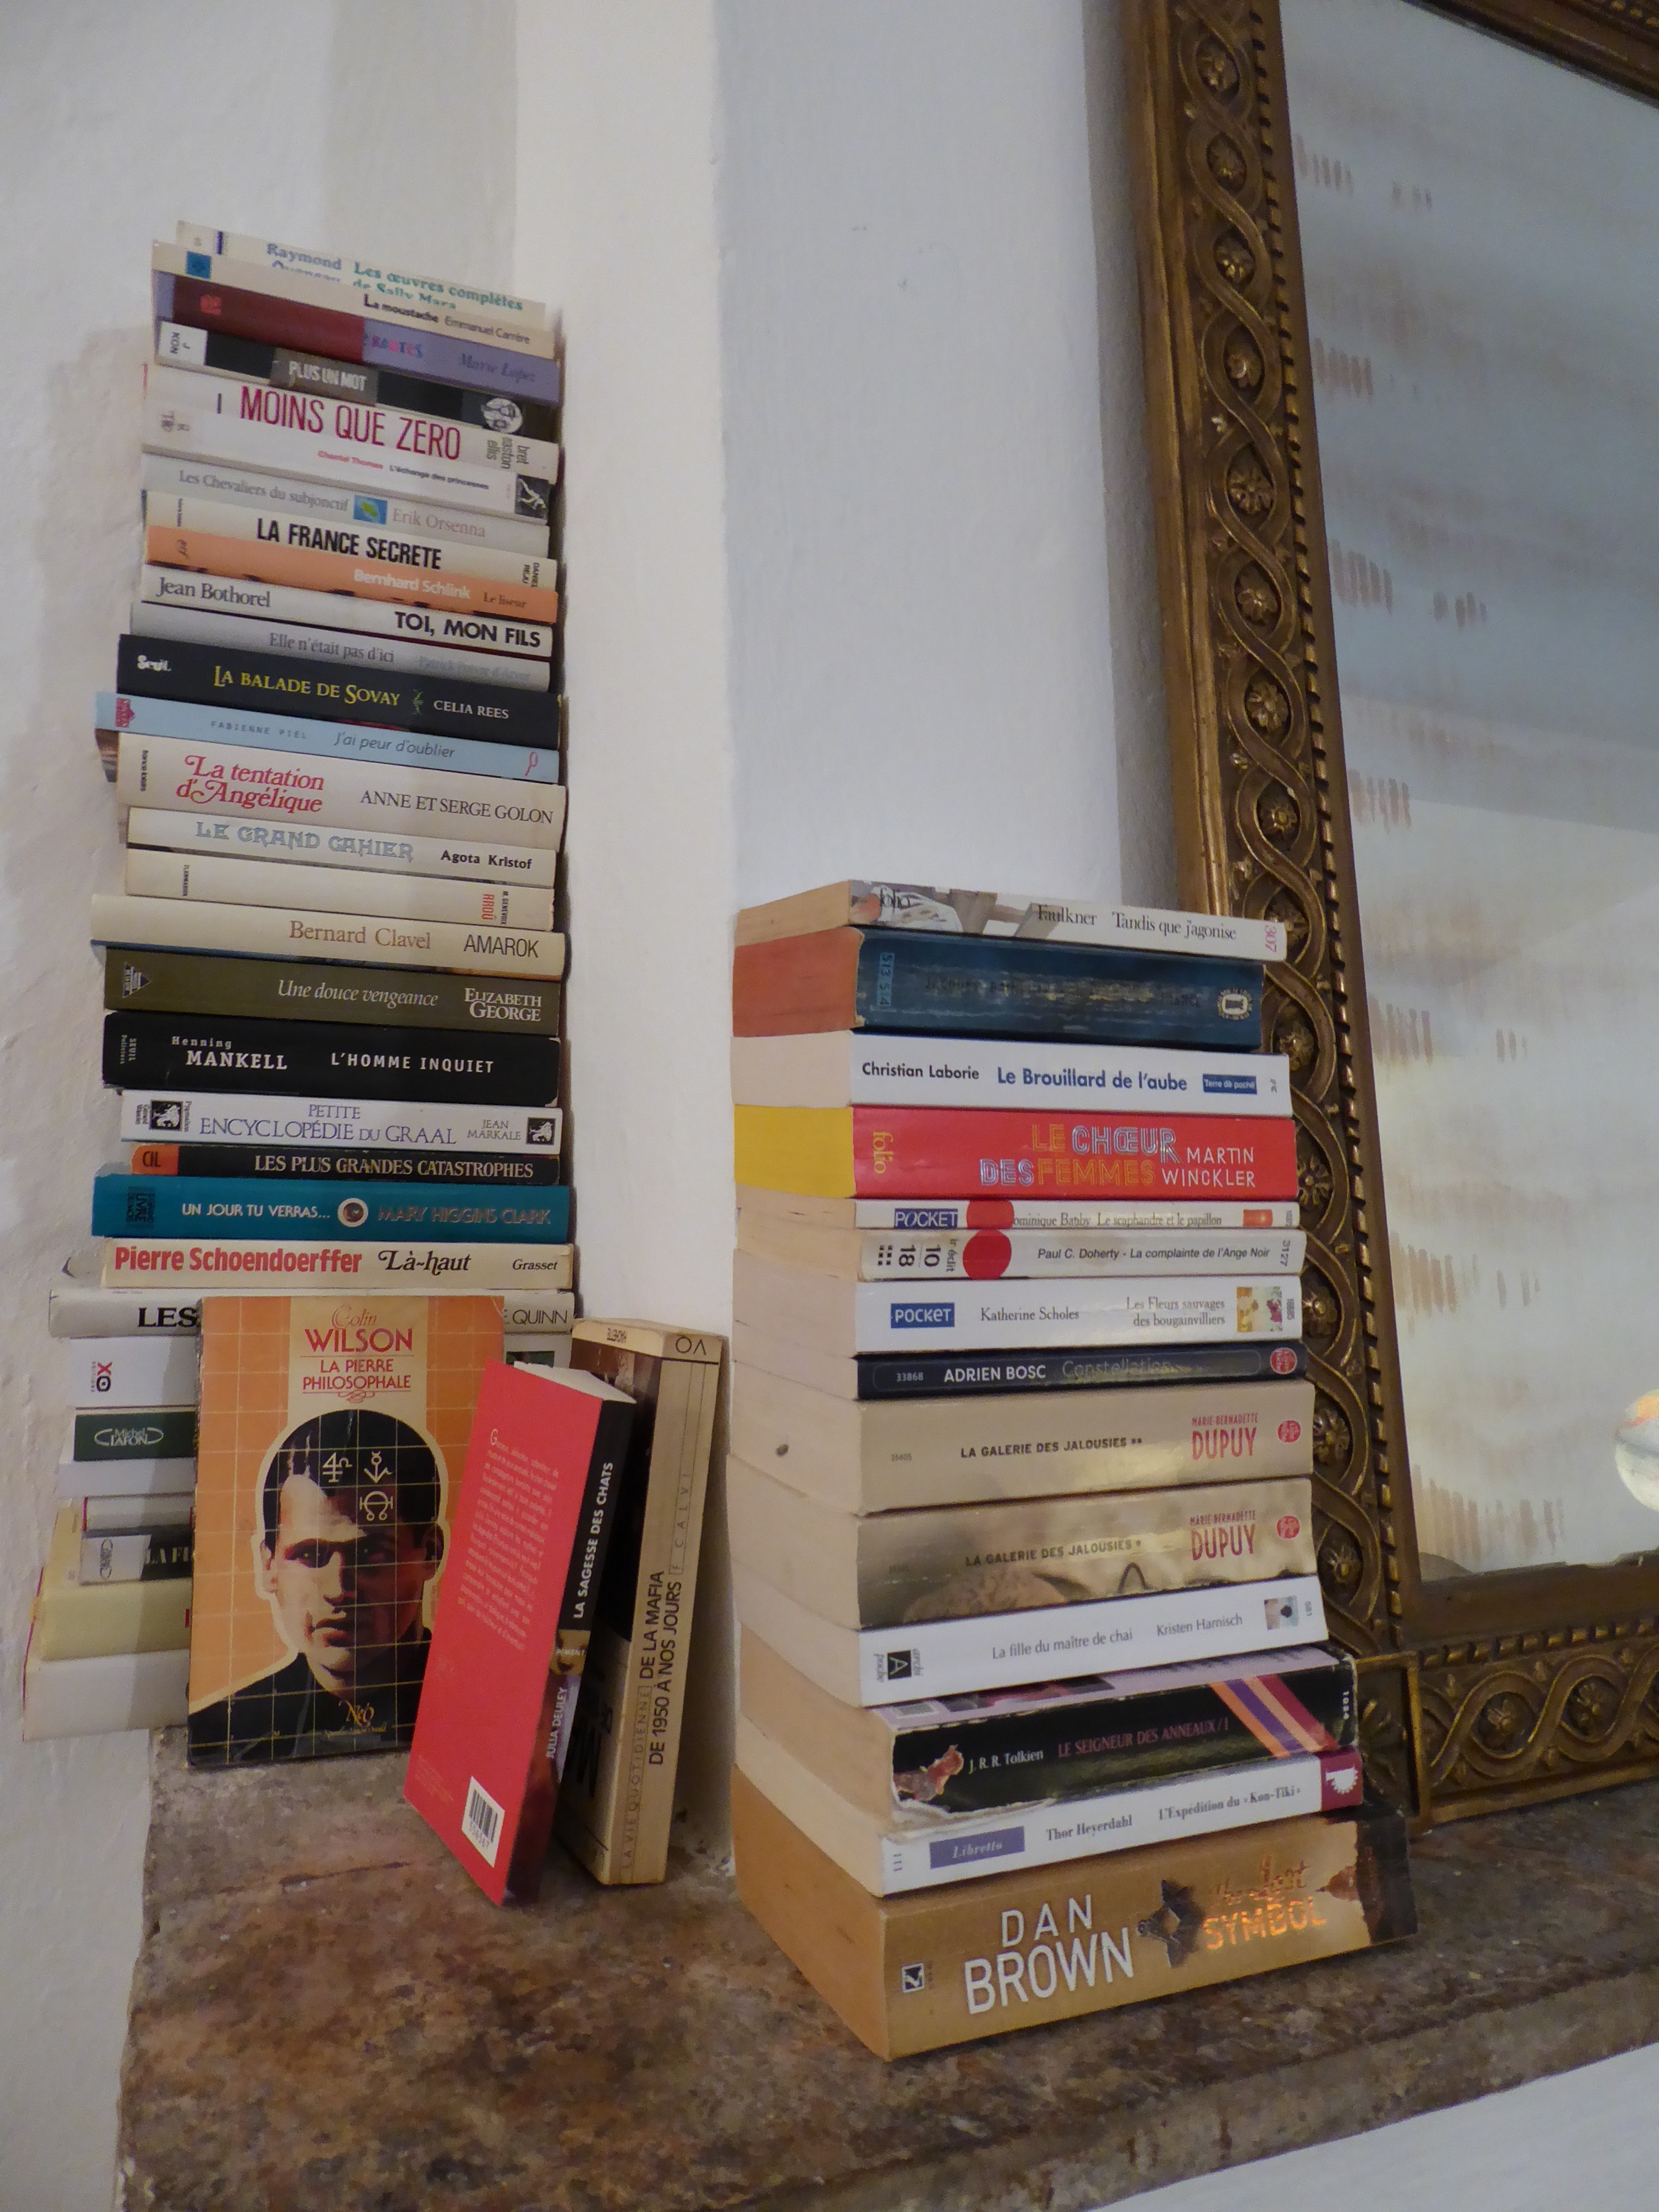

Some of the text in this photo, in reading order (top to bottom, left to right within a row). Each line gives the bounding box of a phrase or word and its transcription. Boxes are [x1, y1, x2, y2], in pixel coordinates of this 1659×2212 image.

[267, 243, 341, 270] Raymond
[289, 361, 321, 379] PLUS
[240, 385, 324, 433] MOINS
[335, 404, 385, 446] QUE
[395, 416, 461, 460] ZERO
[393, 507, 486, 538] Erik Orsenna
[257, 517, 442, 570] LA FRANCE SECRETE
[354, 568, 471, 599] Bernhard Schlink
[156, 576, 541, 648] Jean Bothorel TOI, MON FILS
[269, 632, 295, 649] Elle
[240, 672, 510, 720] BALADE CELIA REES
[395, 739, 455, 758] d'oublier
[184, 755, 325, 791] La tentation
[176, 779, 324, 813] d'Angélique
[360, 790, 554, 825] ANNE ET SERGE GOLON
[237, 826, 533, 869] GRAND CAHIER Agota Kristof
[1037, 904, 1237, 941] Faulkner Tandis que j'agonise
[289, 920, 540, 958] Bernard Clavel AMAROK
[1264, 925, 1277, 953] 307
[278, 980, 542, 1009] Une douce vengeance ELIZABETH
[469, 1001, 541, 1022] GEORGE
[171, 1035, 232, 1050] Henning
[186, 1050, 494, 1074] MANKELL L'HOMME INQUIET
[862, 1061, 1188, 1091] Christian Laborie Le Brouillard de l'aube
[309, 1104, 361, 1119] PETITE
[200, 1117, 510, 1145] ENCYCLOPÉDIE GRAAL JEAN
[467, 1130, 521, 1141] MARKALE
[1031, 1123, 1066, 1152] LE
[254, 1155, 534, 1178] LES PLUS GRANDES CATASTROPHES
[872, 1131, 894, 1175] folio
[1186, 1146, 1254, 1165] MARTIN
[979, 1157, 1155, 1187] DES FEMMES
[1161, 1167, 1256, 1188] WINCKLER
[182, 1203, 551, 1225] UN JOUR MARY HIGGINS CLARK
[895, 1210, 958, 1228] POCKET
[115, 1245, 559, 1276] Pierre Schoendoerffer Là-haut Grasset
[1038, 1248, 1270, 1260] Paul Doherty complainte Noir
[332, 1304, 378, 1329] Colin
[981, 1306, 1079, 1322] Katherine Scholes
[1148, 1296, 1225, 1311] Fleurs sauvages
[138, 1307, 568, 1328] LES QUINN
[1154, 1311, 1225, 1328] bougainvilliers
[304, 1328, 413, 1353] WILSON
[321, 1358, 394, 1373] LA PIERRE
[943, 1364, 1047, 1383] ADRIEN BOSC
[302, 1375, 412, 1390] PHILOSOPHALE
[961, 1438, 1127, 1459] LA GALERIE DES JALOUSIES
[1192, 1426, 1257, 1461] DUPUY
[573, 1462, 614, 1619] LA SAGESSE DES CHATS
[986, 1540, 1133, 1565] GALERIE DES JALOUSIES
[1191, 1524, 1256, 1561] DUPUY
[639, 1570, 665, 1679] DE LA MAFIA
[1157, 1613, 1243, 1637] Kristen Harnisch
[649, 1580, 682, 1766] DE 1950 NOS JOURS
[1004, 1749, 1044, 1766] Tolkien
[1074, 1733, 1133, 1755] SEIGNEUR
[1137, 1728, 1159, 1745] DES
[1161, 1722, 1215, 1741] ANNEAUX
[1046, 1827, 1073, 1841] Thor
[1000, 1893, 1093, 1948] DAN
[964, 1895, 1328, 2015] BROWN SYMBOL
